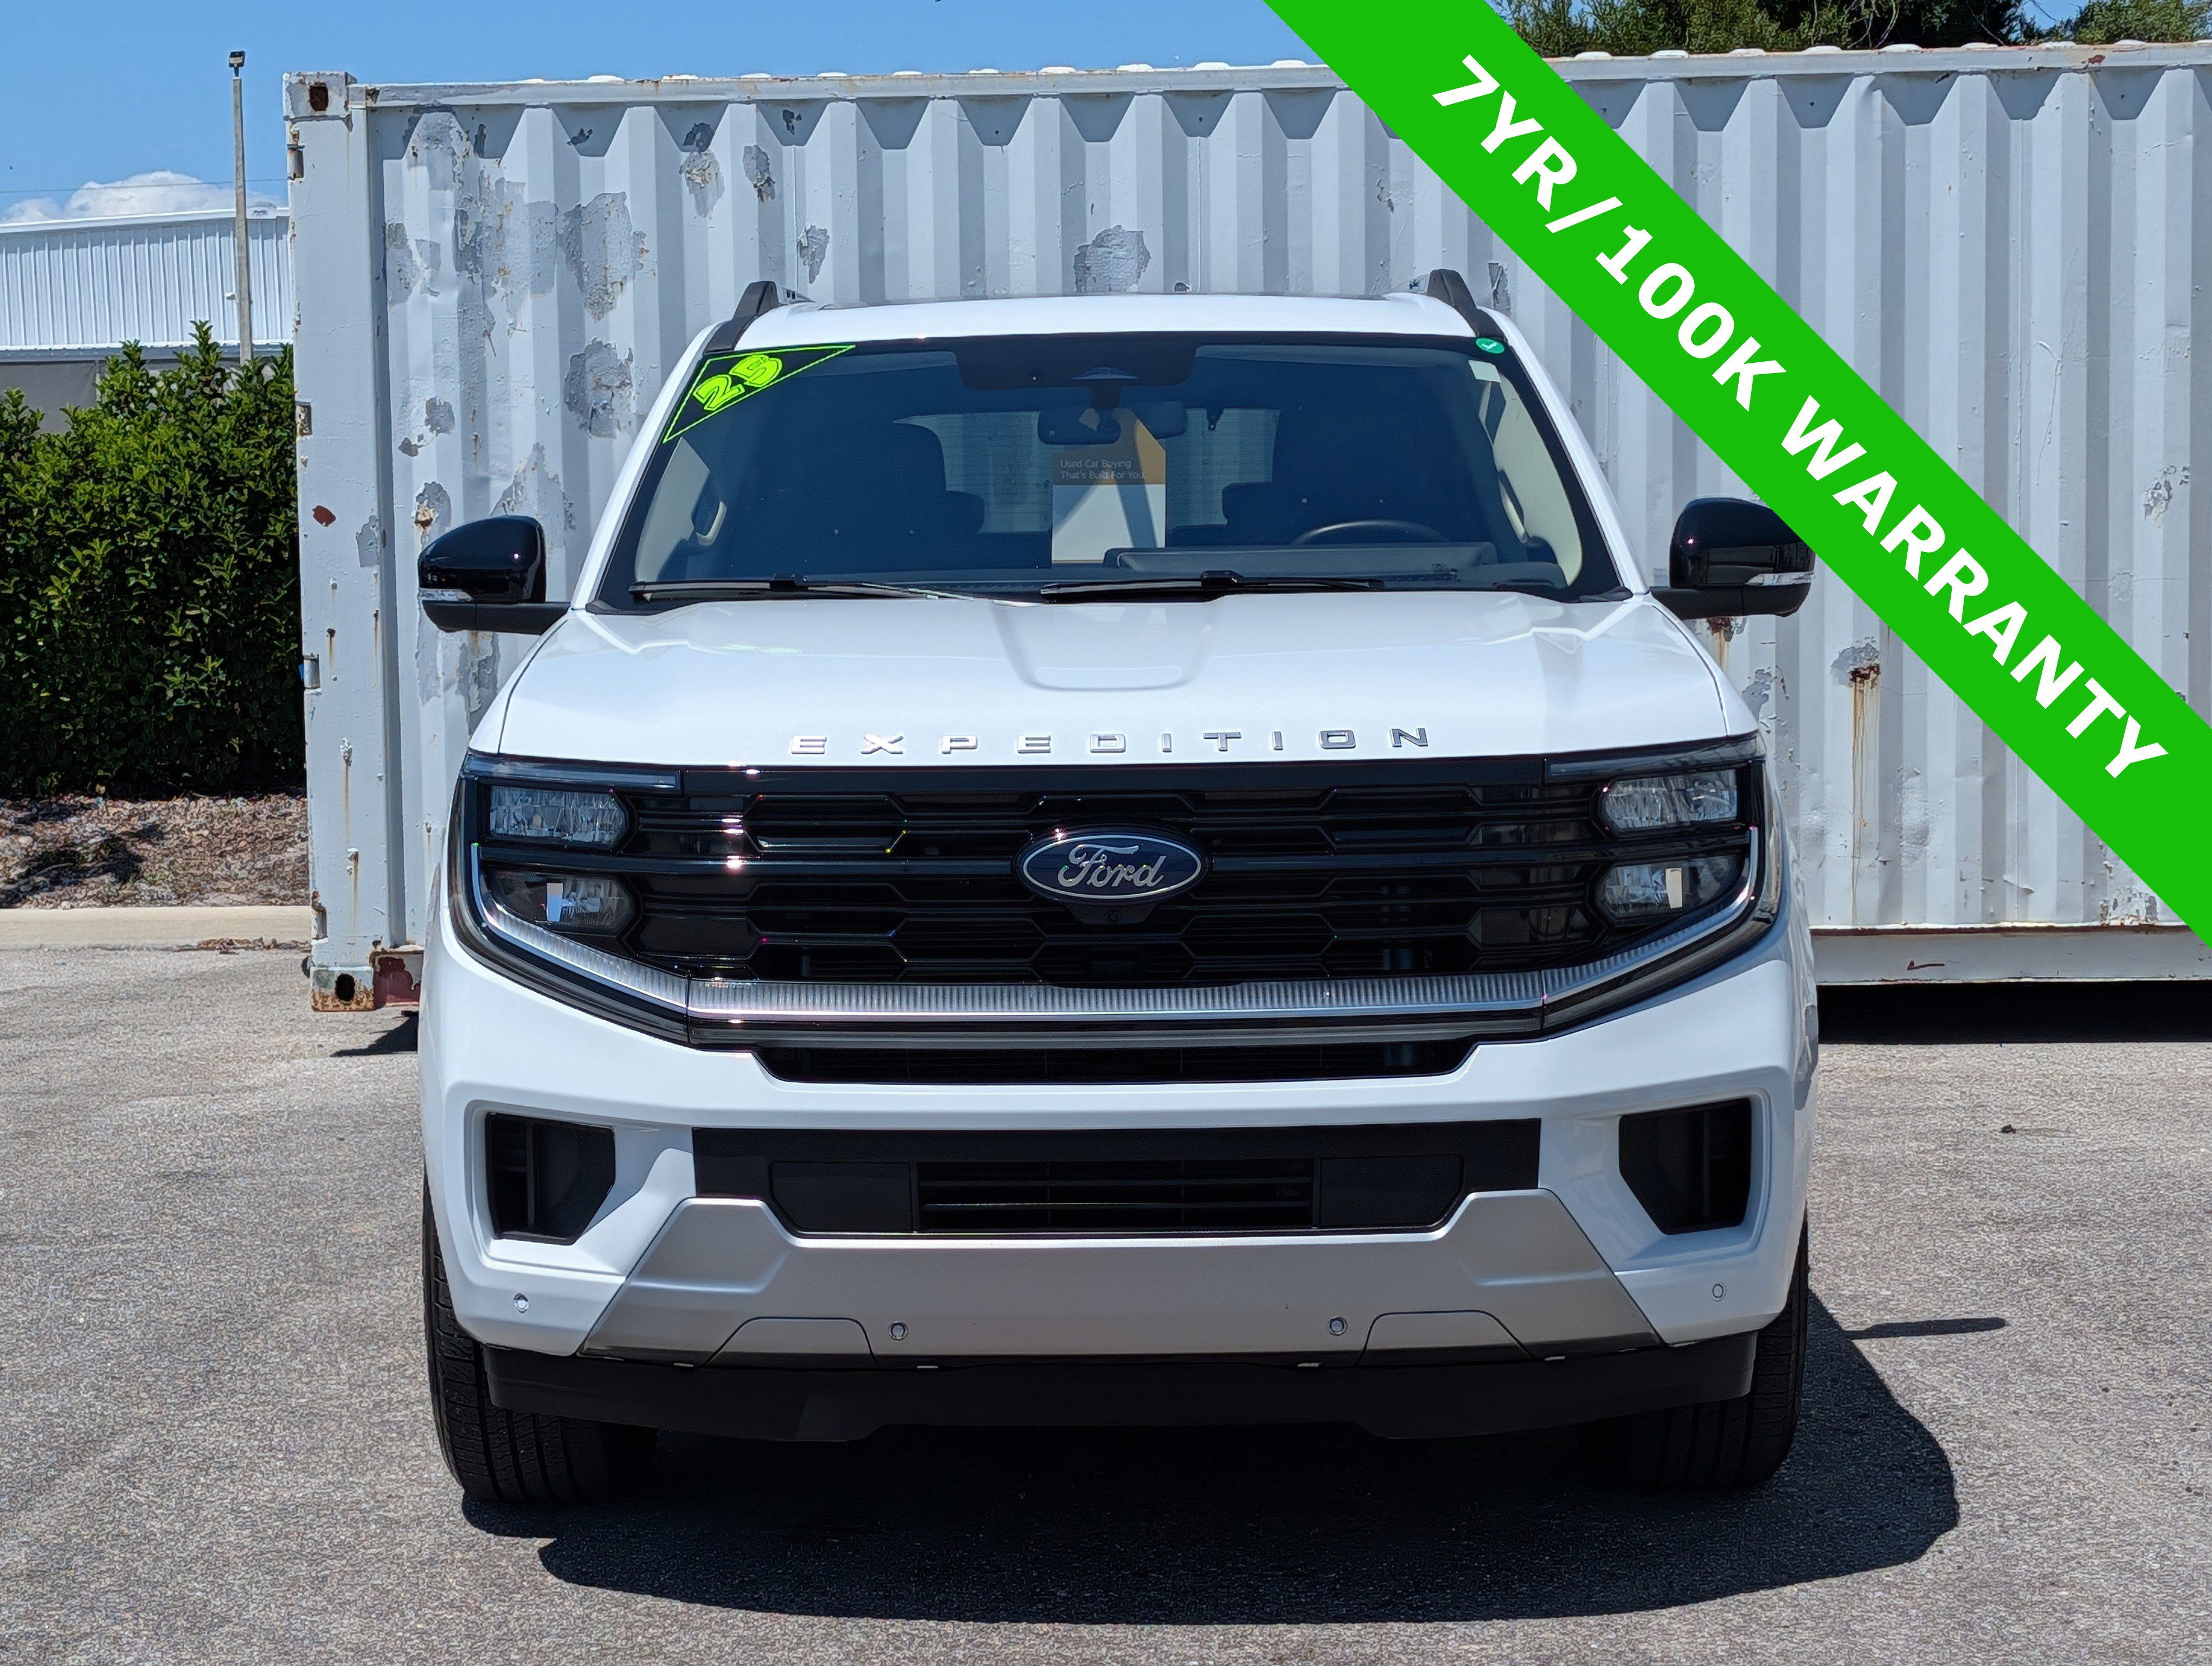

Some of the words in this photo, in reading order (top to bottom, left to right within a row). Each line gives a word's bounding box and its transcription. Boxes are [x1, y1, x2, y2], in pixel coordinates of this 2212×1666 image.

[1060, 459, 1083, 468] Used
[1085, 459, 1099, 468] Car
[1102, 459, 1132, 470] Buying
[1060, 471, 1086, 479] That's
[1089, 471, 1109, 479] Built
[1111, 471, 1125, 479] For
[1128, 471, 1146, 479] You.
[791, 728, 1429, 754] EXPEDITION
[1057, 844, 1167, 887] Ford
